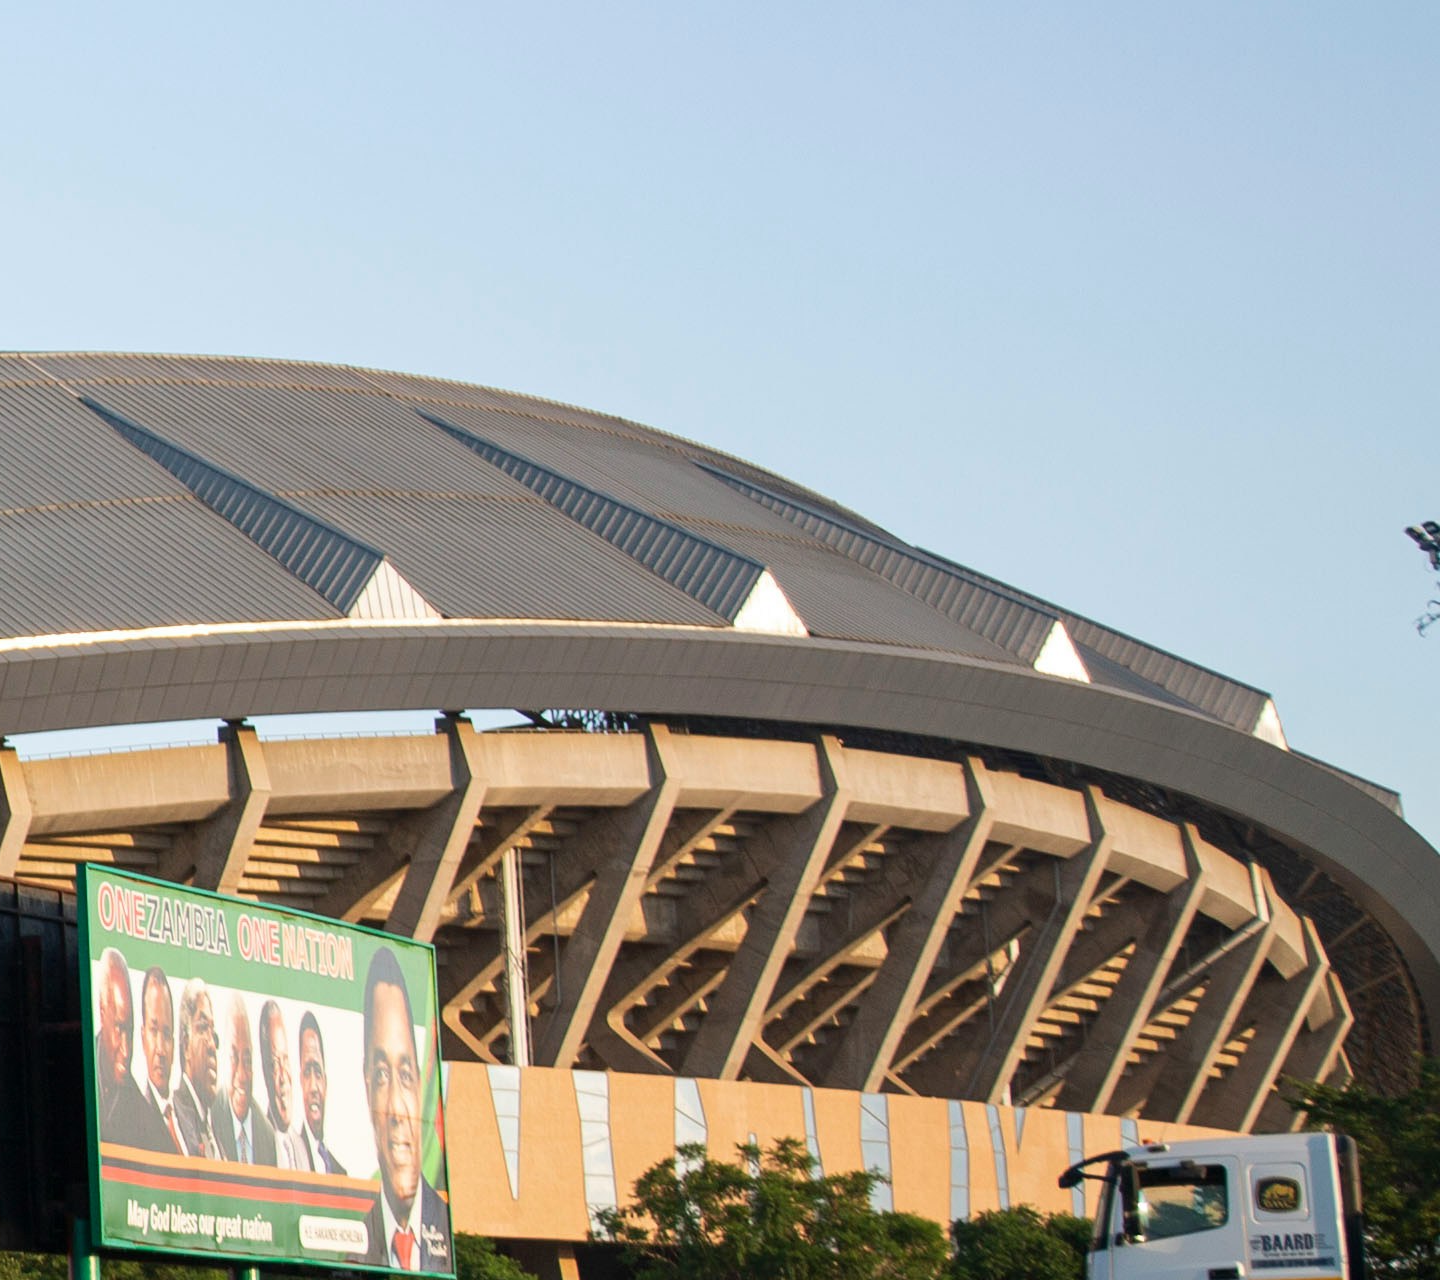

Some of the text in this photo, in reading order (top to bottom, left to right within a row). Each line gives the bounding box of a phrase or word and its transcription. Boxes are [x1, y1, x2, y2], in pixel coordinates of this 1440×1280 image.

[98, 881, 354, 980] ONE ZAMBIA ONE NATION
[127, 1199, 272, 1244] May God bless our great nation
[1261, 1234, 1314, 1252] BAARD
